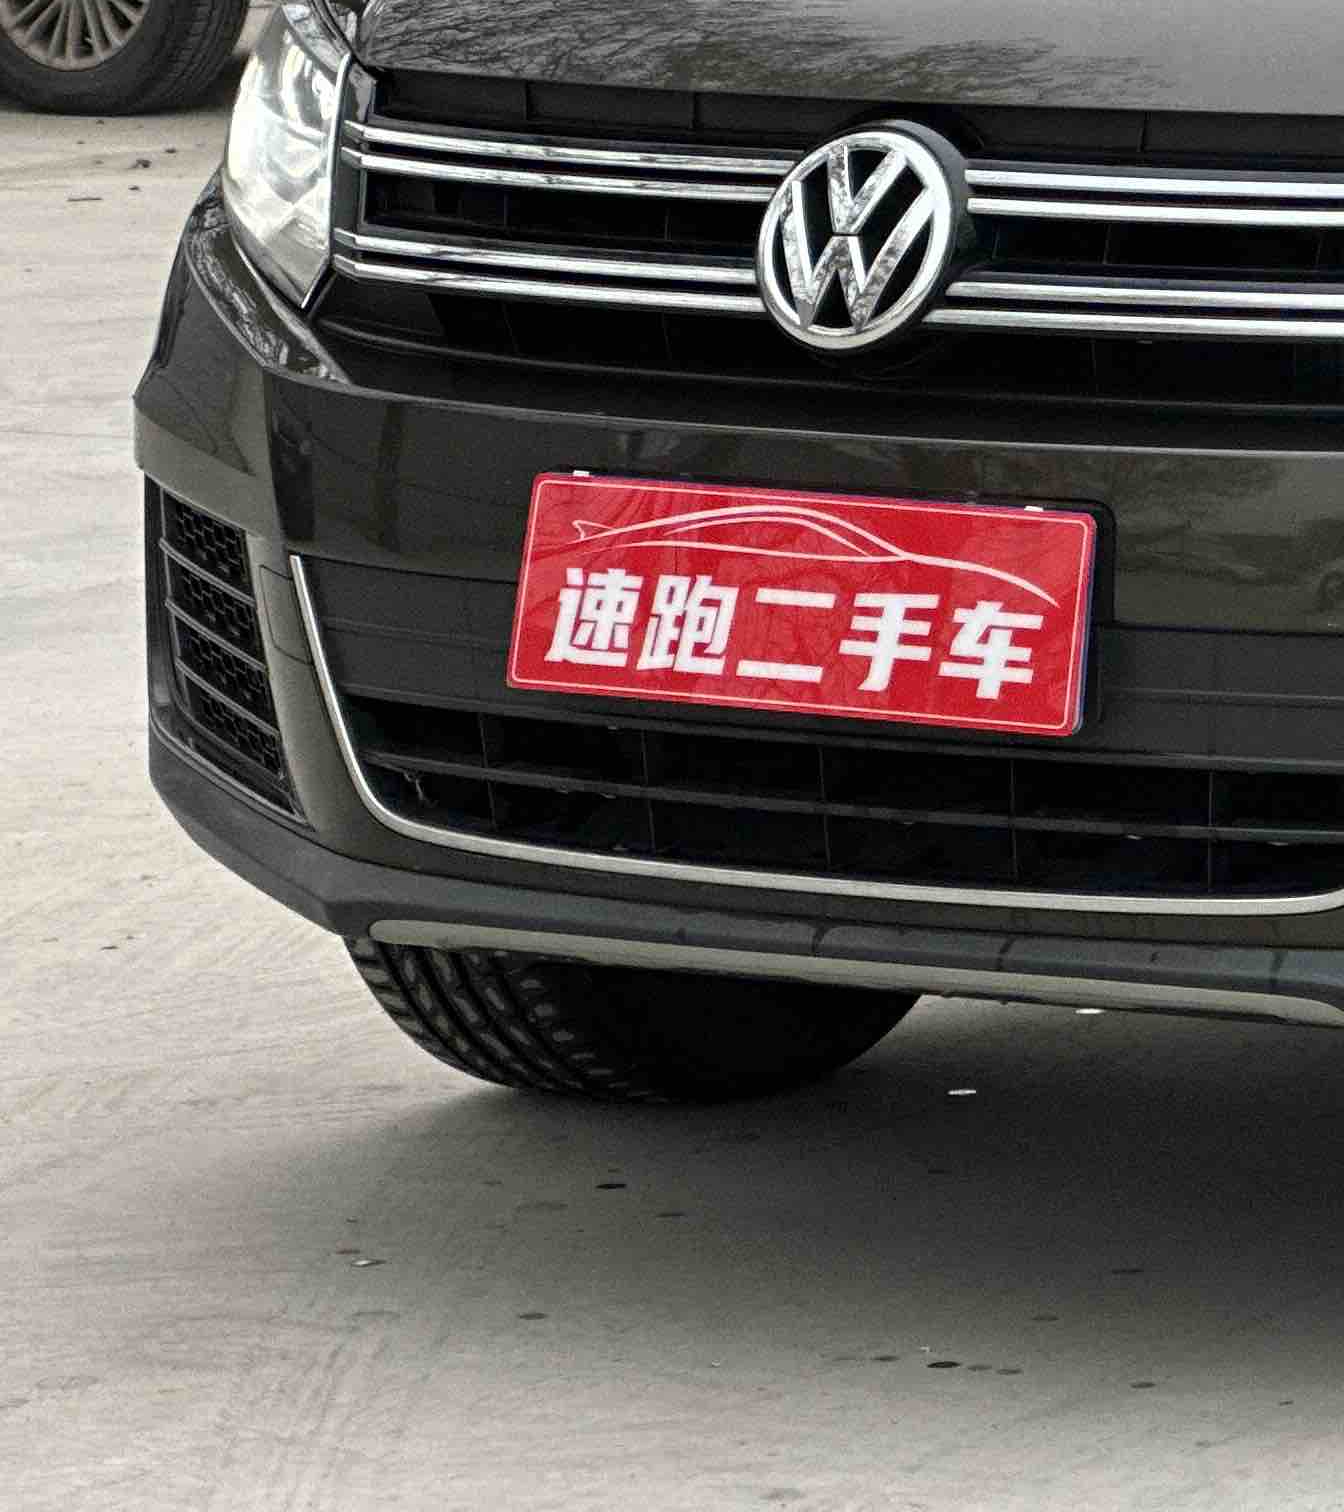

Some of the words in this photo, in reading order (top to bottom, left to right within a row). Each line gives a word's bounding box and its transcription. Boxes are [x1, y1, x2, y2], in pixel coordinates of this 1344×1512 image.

[766, 136, 946, 341] VW
[544, 567, 1044, 700] 速跑二手车
